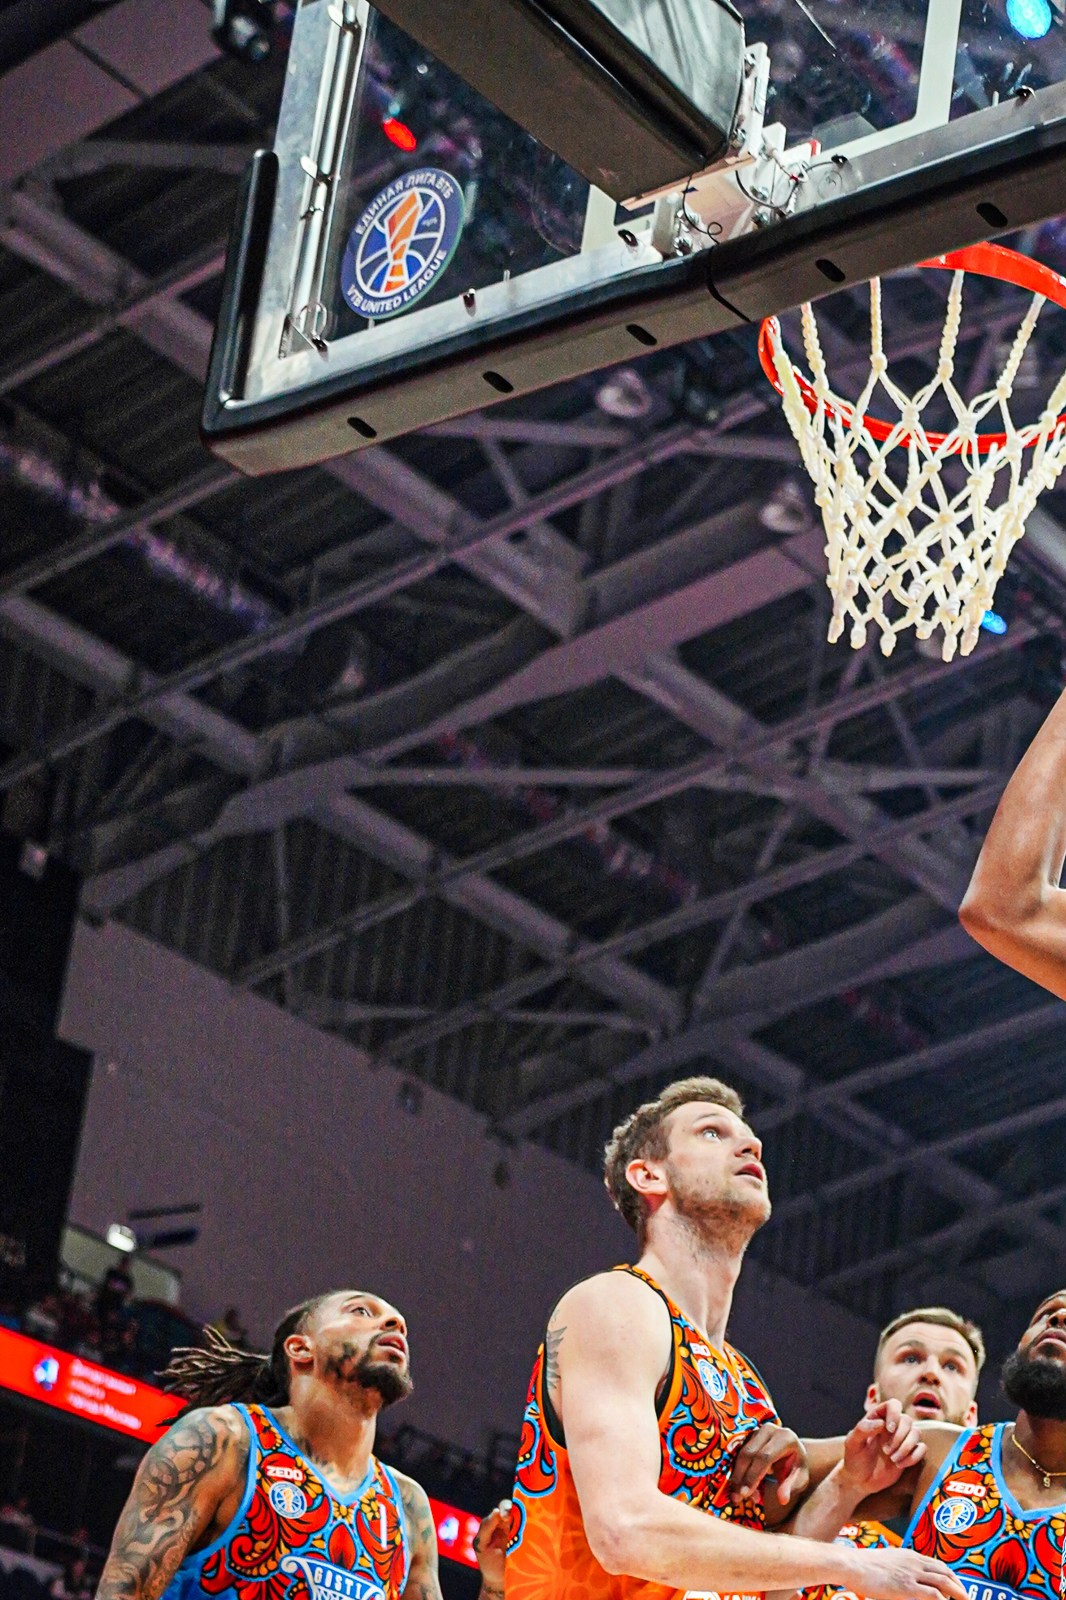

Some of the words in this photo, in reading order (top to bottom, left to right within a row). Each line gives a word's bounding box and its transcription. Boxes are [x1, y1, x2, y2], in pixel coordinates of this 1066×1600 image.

[355, 178, 404, 236] ЕДИНАЯ
[405, 172, 436, 189] ЛИГА
[347, 284, 364, 308] VTB
[361, 295, 402, 314] UNITED
[403, 250, 448, 301] LEAGUE
[266, 1465, 304, 1481] ZEDO
[946, 1480, 986, 1497] ZEDO
[313, 1565, 363, 1600] GOSTI
